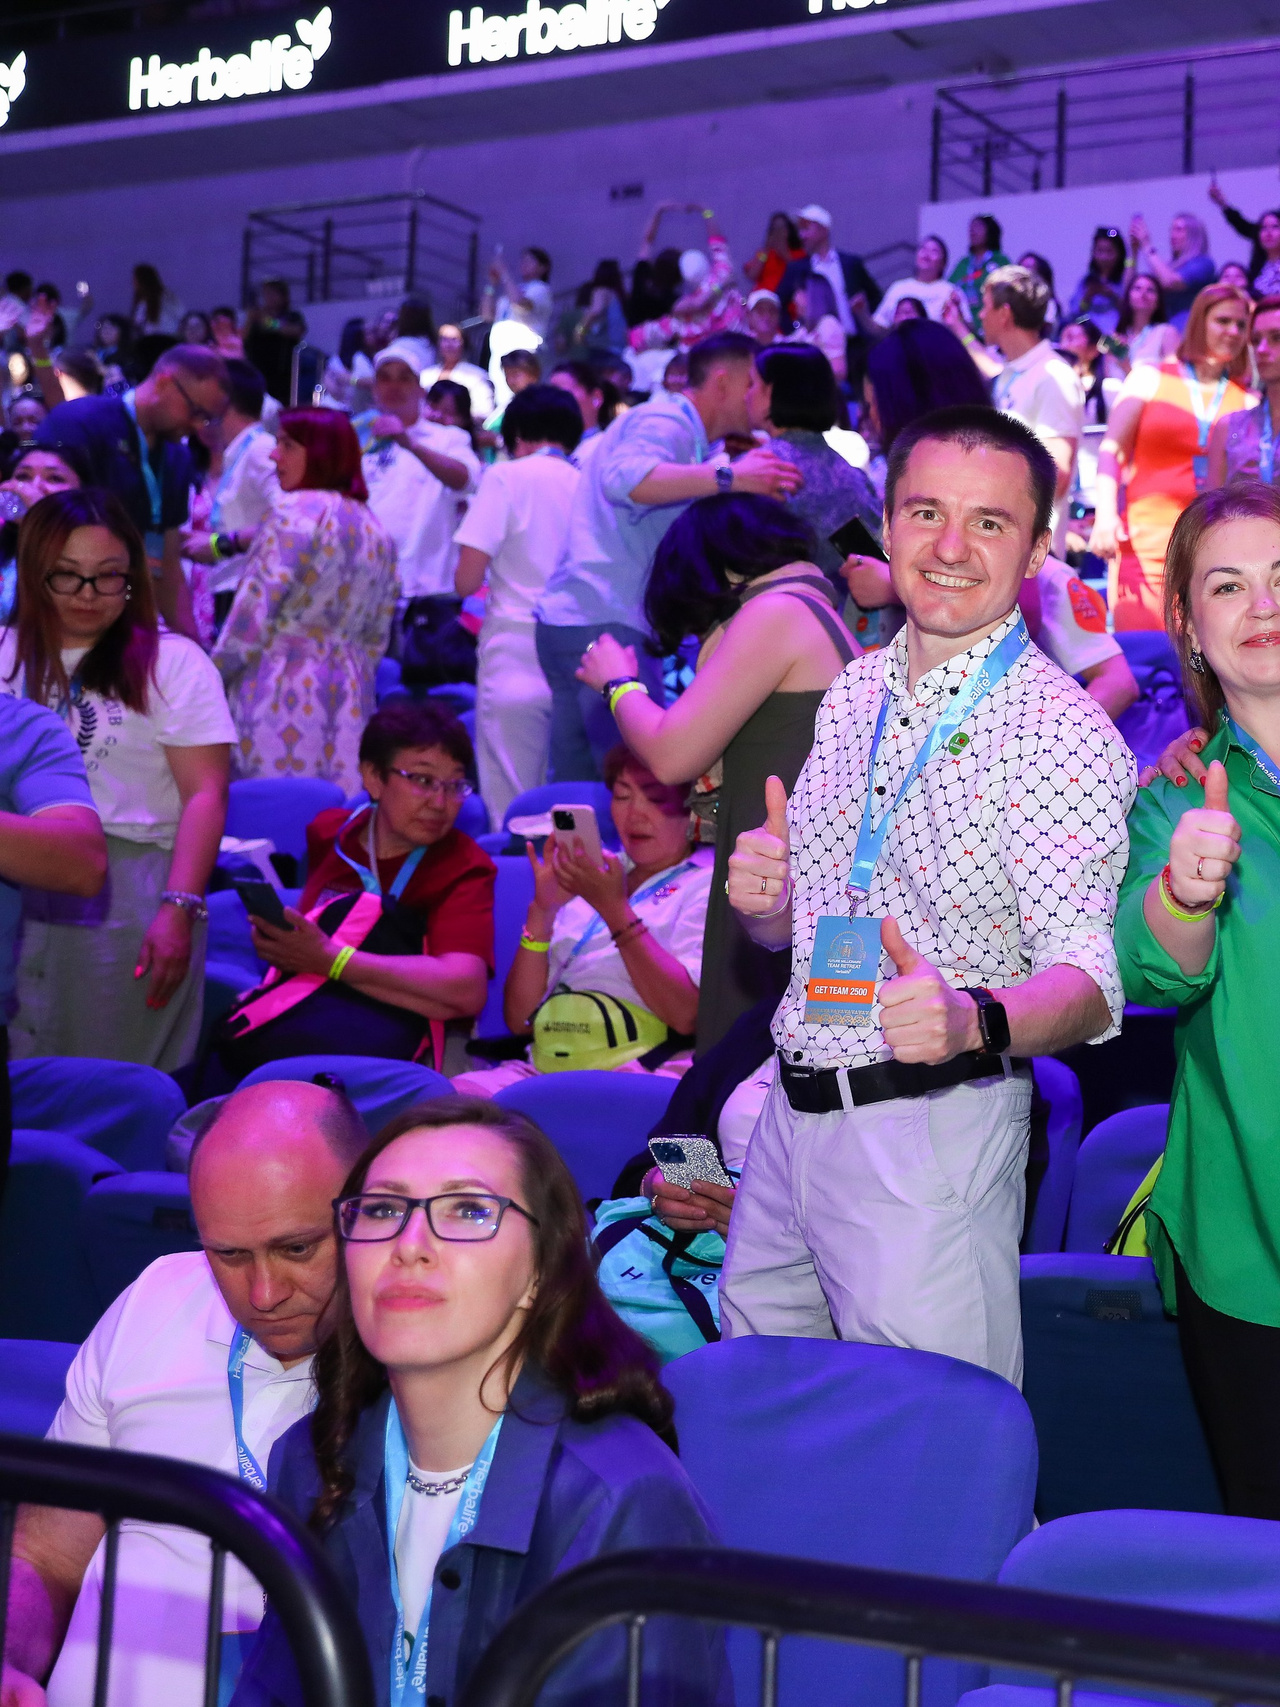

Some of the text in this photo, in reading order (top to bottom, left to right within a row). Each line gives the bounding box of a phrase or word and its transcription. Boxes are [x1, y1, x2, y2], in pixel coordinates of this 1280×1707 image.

[448, 0, 659, 66] Herbalife
[129, 34, 314, 110] Herbalife
[814, 985, 868, 996] GET TEAM 2500
[233, 1331, 250, 1379] Herbal
[458, 1459, 491, 1533] Herbalife
